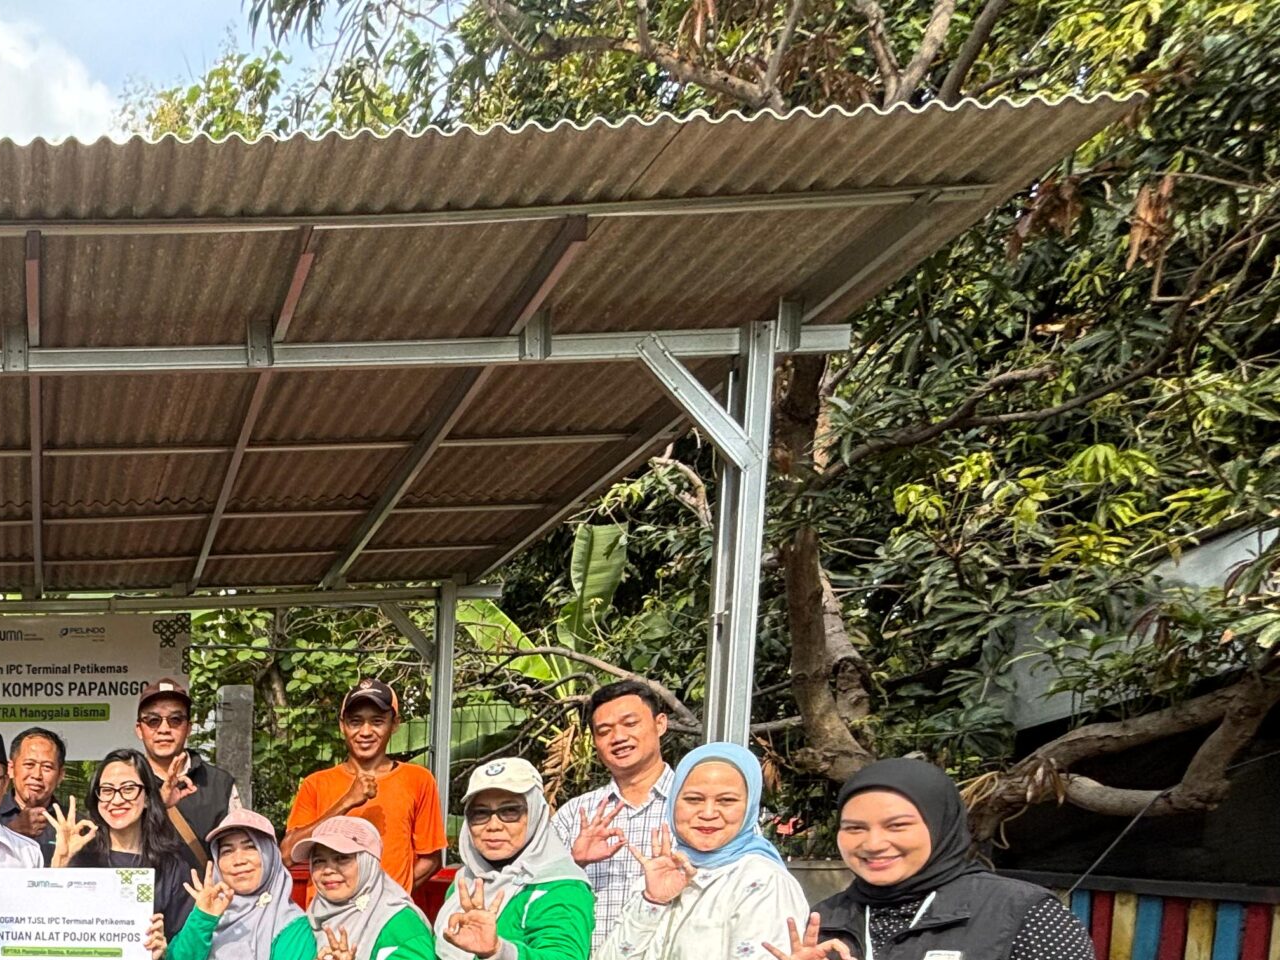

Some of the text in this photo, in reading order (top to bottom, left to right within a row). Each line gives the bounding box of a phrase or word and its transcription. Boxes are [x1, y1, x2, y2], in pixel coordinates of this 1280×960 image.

[6, 664, 23, 675] IPC
[25, 663, 71, 675] Terminal
[73, 663, 129, 674] Petikemas
[2, 681, 64, 697] KOMPOS
[19, 706, 70, 720] Manggala
[72, 706, 106, 717] Bisma
[28, 917, 46, 925] TJSL
[47, 917, 61, 925] IPC
[62, 917, 94, 926] Terminal
[95, 918, 135, 926] Petikemas
[34, 931, 61, 942] ALAT
[63, 932, 97, 942] POJOK
[99, 932, 141, 943] KOMPOS
